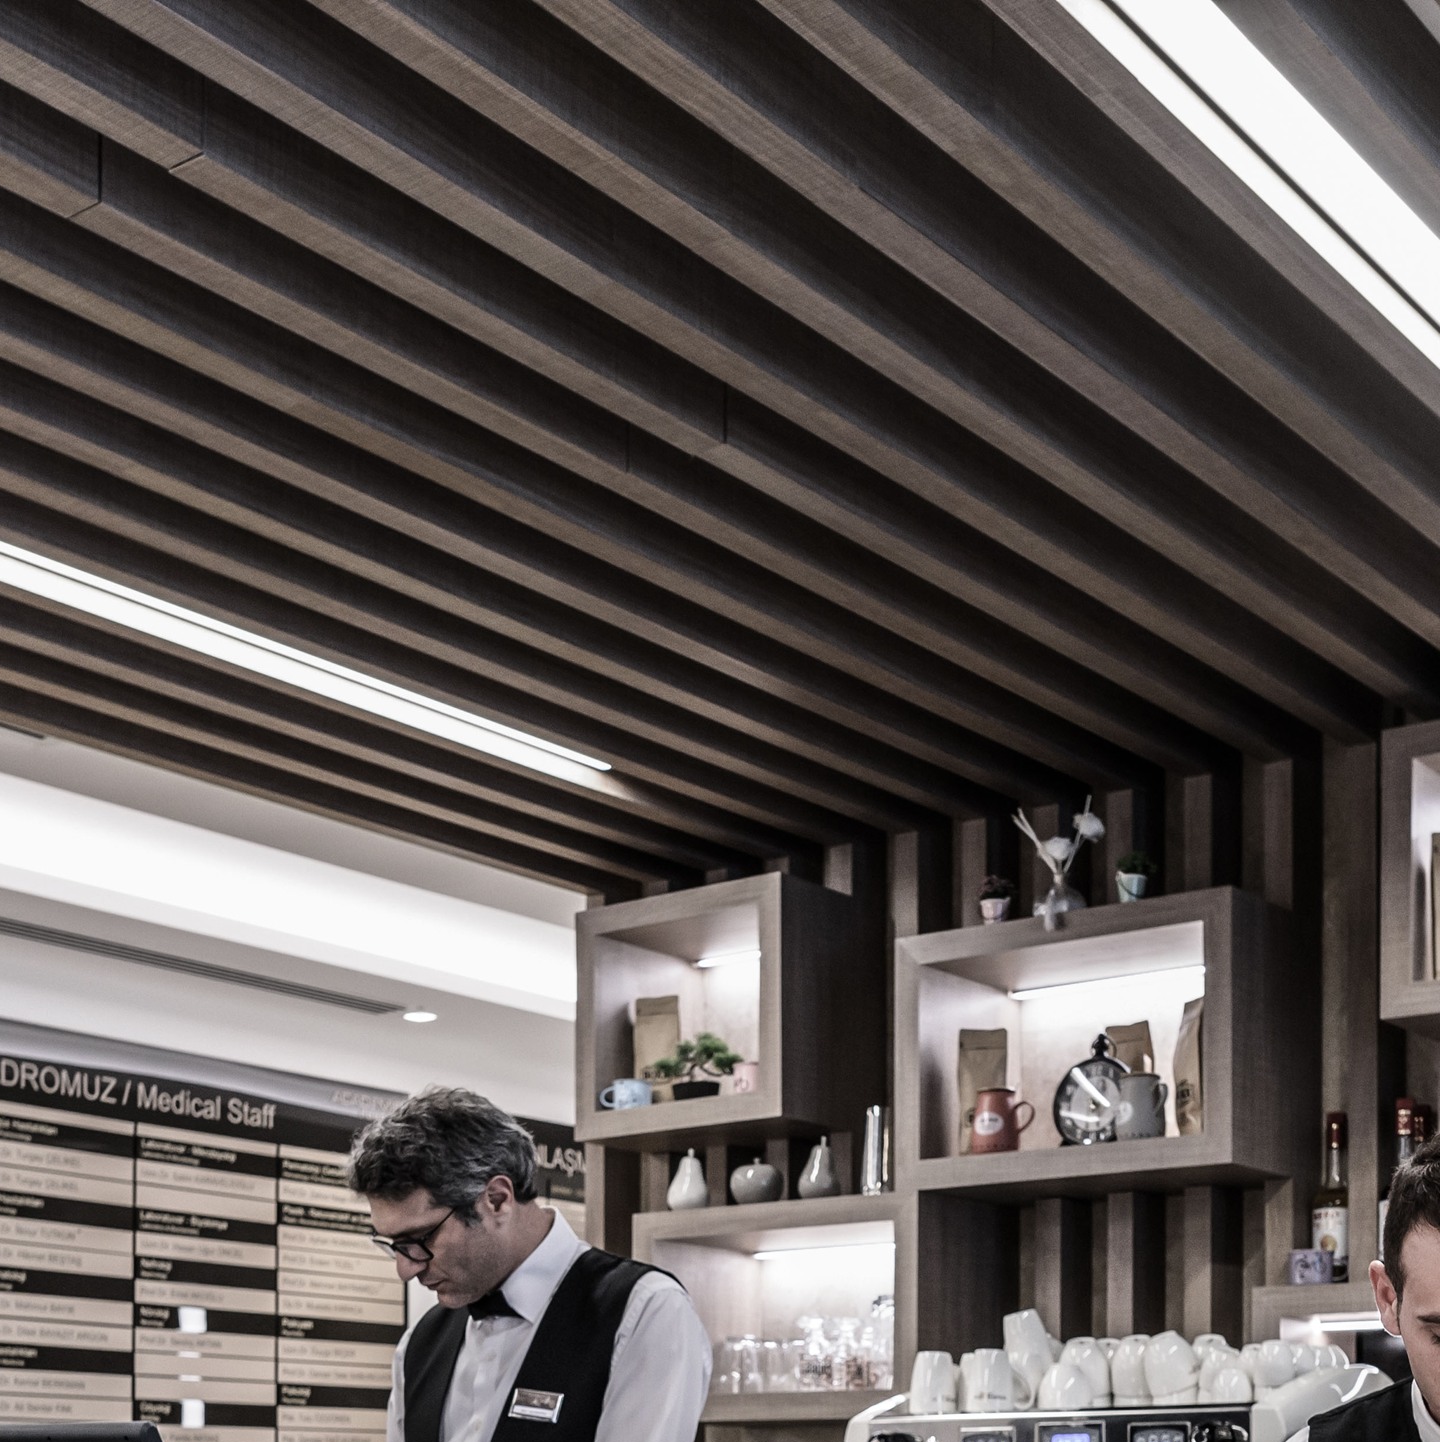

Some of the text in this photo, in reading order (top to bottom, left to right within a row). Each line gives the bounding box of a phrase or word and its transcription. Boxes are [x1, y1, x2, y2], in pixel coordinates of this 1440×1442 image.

[122, 1079, 132, 1106] /
[136, 1081, 221, 1121] Medical
[226, 1099, 277, 1129] Staff
